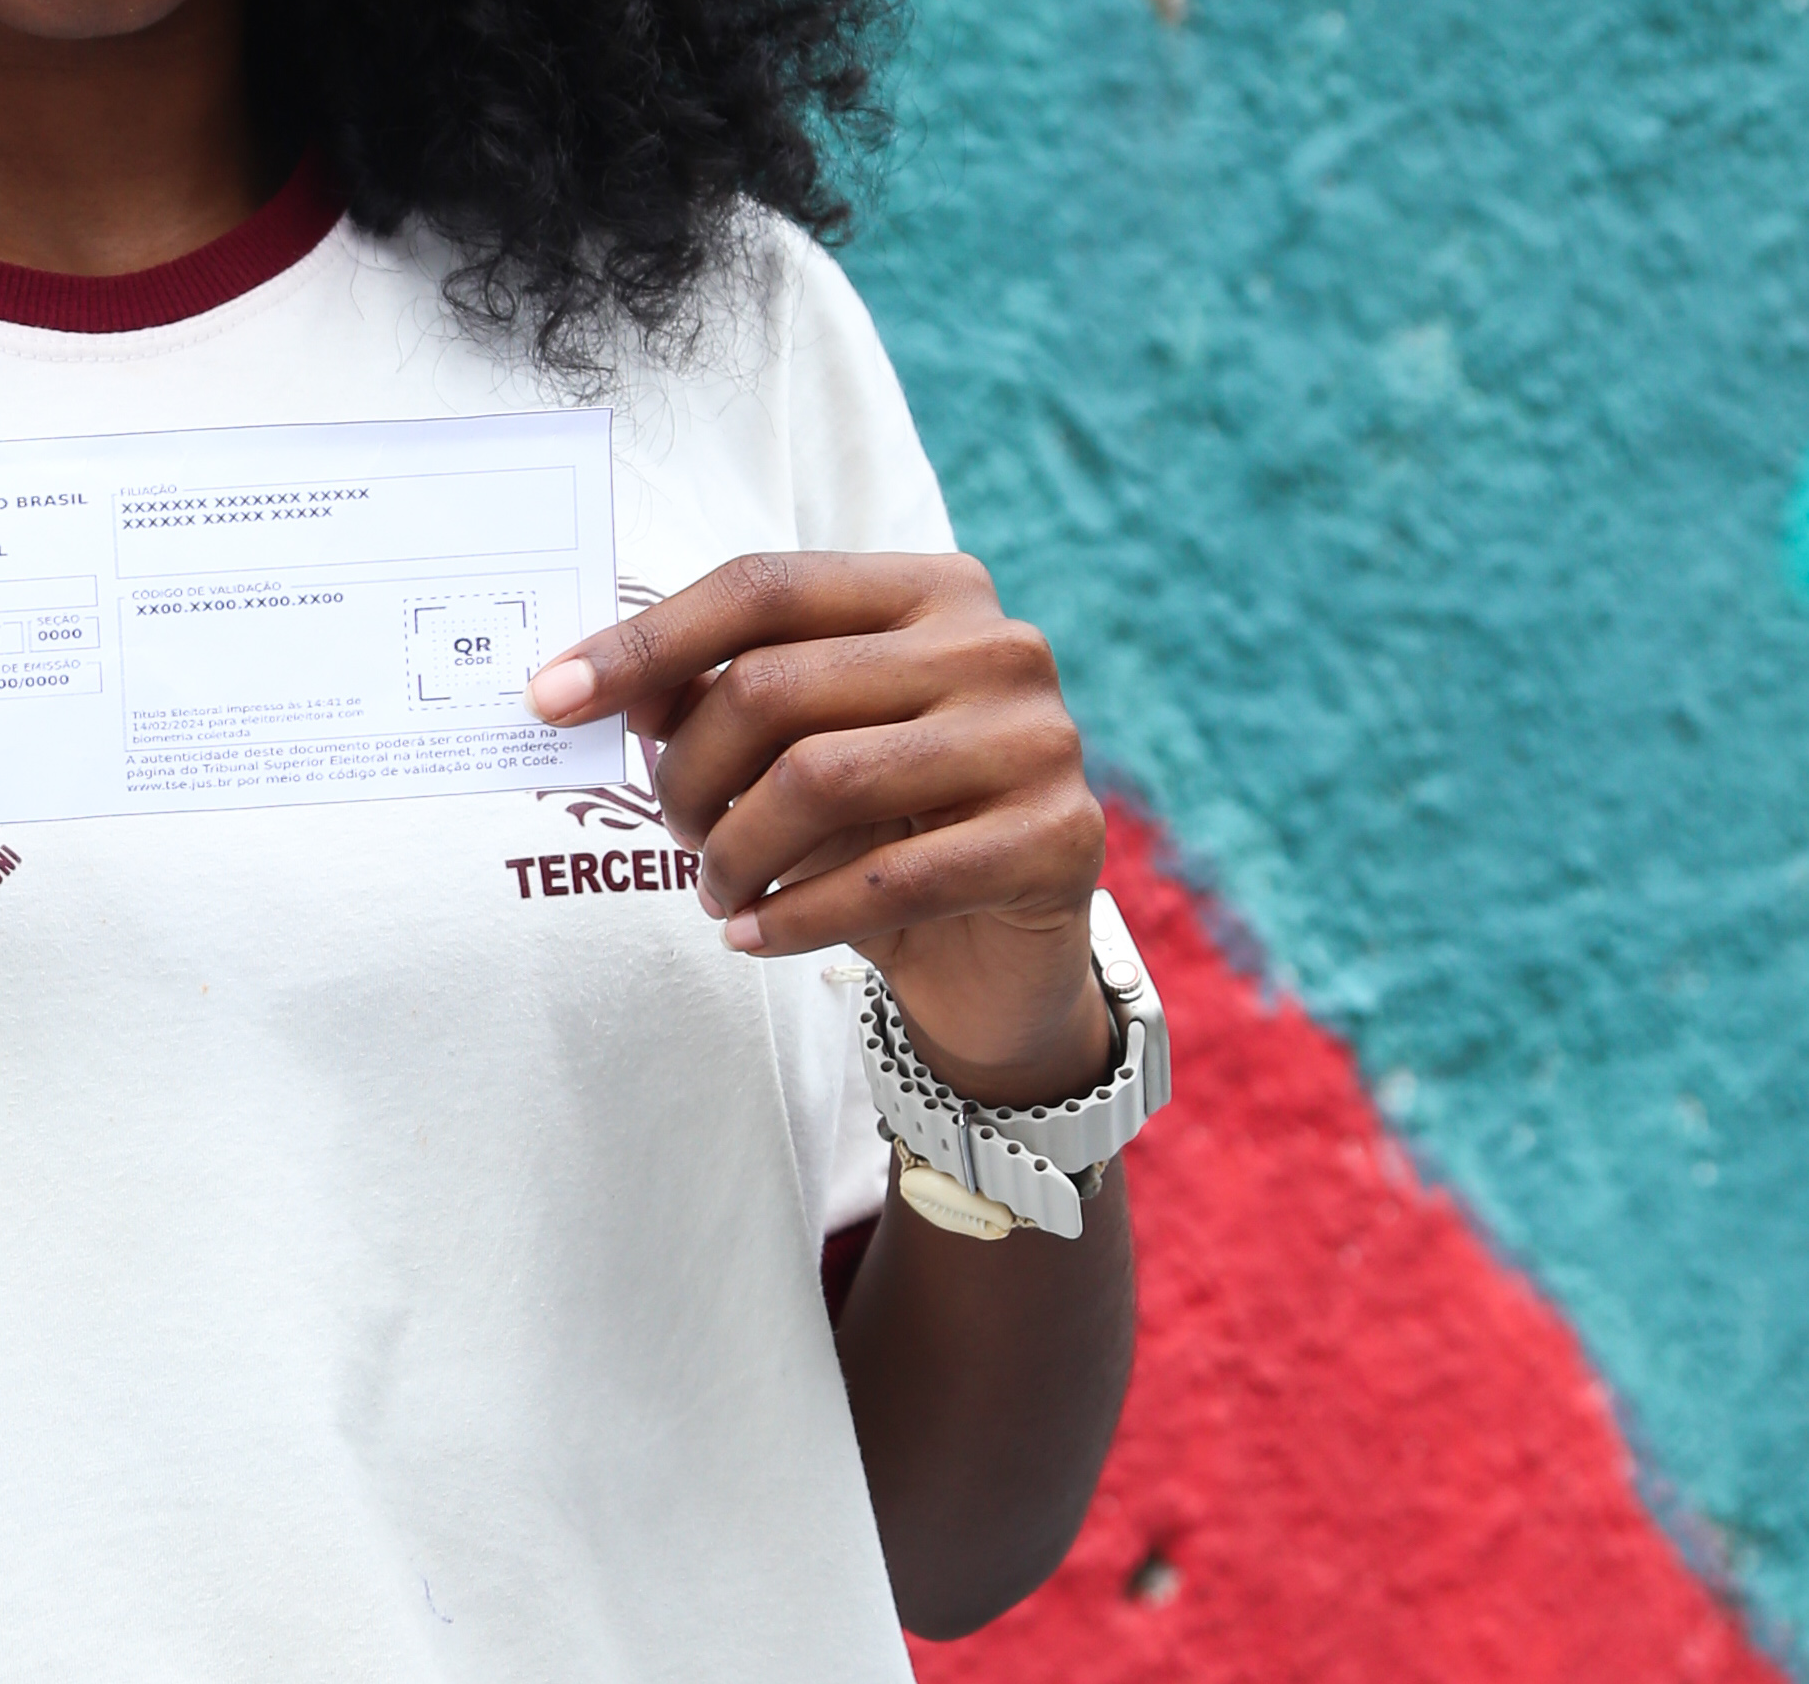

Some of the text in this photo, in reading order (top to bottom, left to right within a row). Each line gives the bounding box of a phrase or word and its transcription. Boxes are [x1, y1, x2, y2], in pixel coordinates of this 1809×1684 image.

[16, 493, 89, 508] BRASIL
[190, 587, 205, 596] DE
[453, 636, 492, 656] QR
[2, 663, 19, 673] DE
[455, 656, 492, 666] CODE
[126, 729, 557, 765] A autenticidade deste documento poderá ser confirmada na
[126, 766, 175, 780] página
[180, 764, 198, 775] do
[203, 762, 259, 773] Tribunal
[264, 758, 324, 772] Superior
[330, 752, 389, 765] Eleitoral
[393, 752, 411, 761] na
[481, 746, 498, 755] no
[237, 776, 260, 787] por
[266, 773, 301, 783] meio
[306, 770, 324, 781] do
[380, 767, 398, 776] de
[476, 761, 492, 769] ou
[497, 758, 518, 769] QR
[505, 849, 701, 899] TERCEIR
